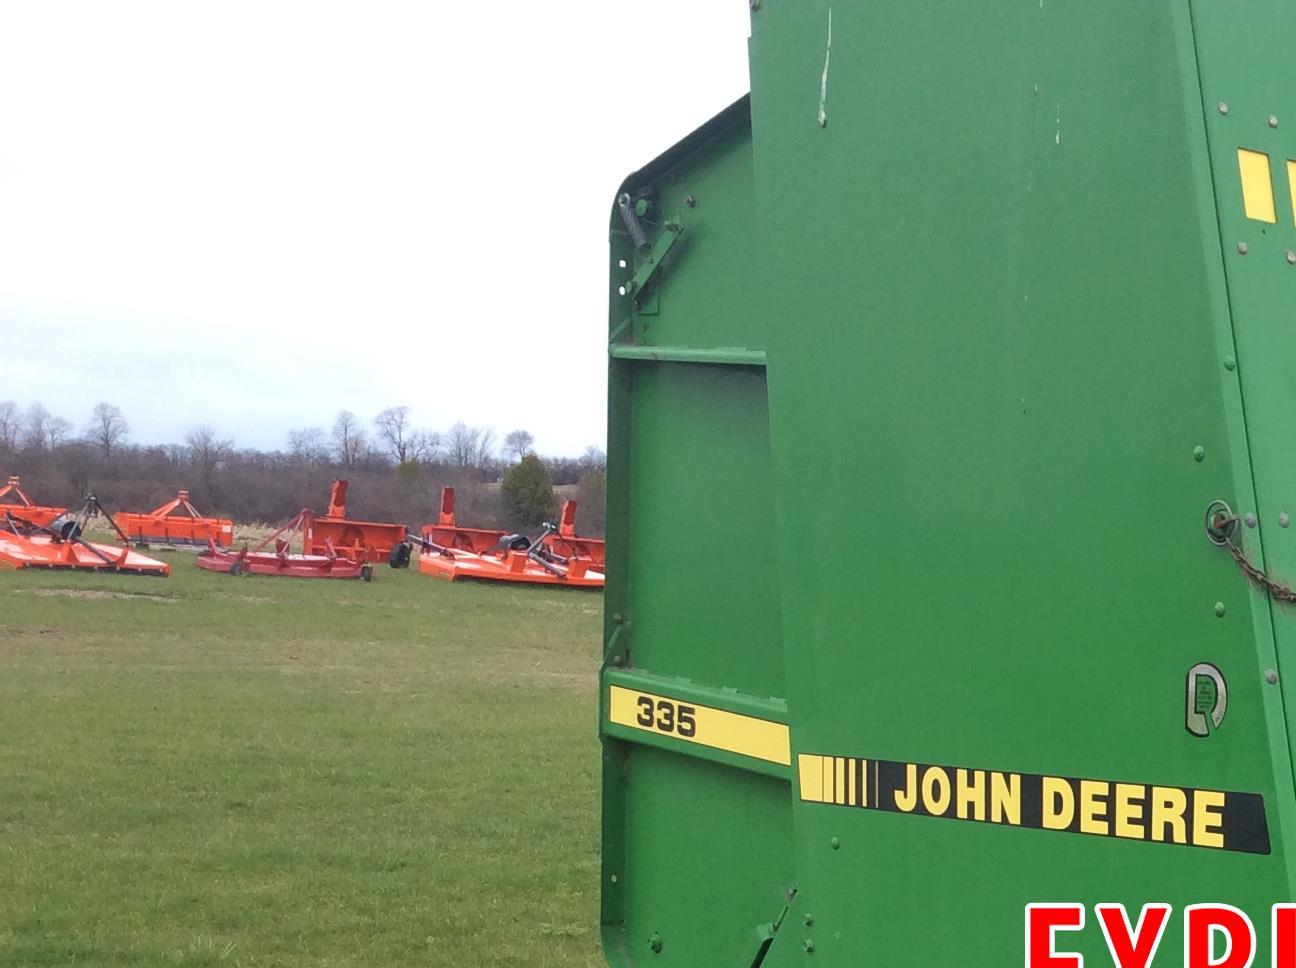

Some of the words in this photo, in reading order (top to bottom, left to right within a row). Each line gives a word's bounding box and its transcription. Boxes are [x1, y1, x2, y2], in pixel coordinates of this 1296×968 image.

[637, 696, 696, 738] 335
[893, 763, 1021, 825] JOHN
[1042, 776, 1226, 849] DEERE
